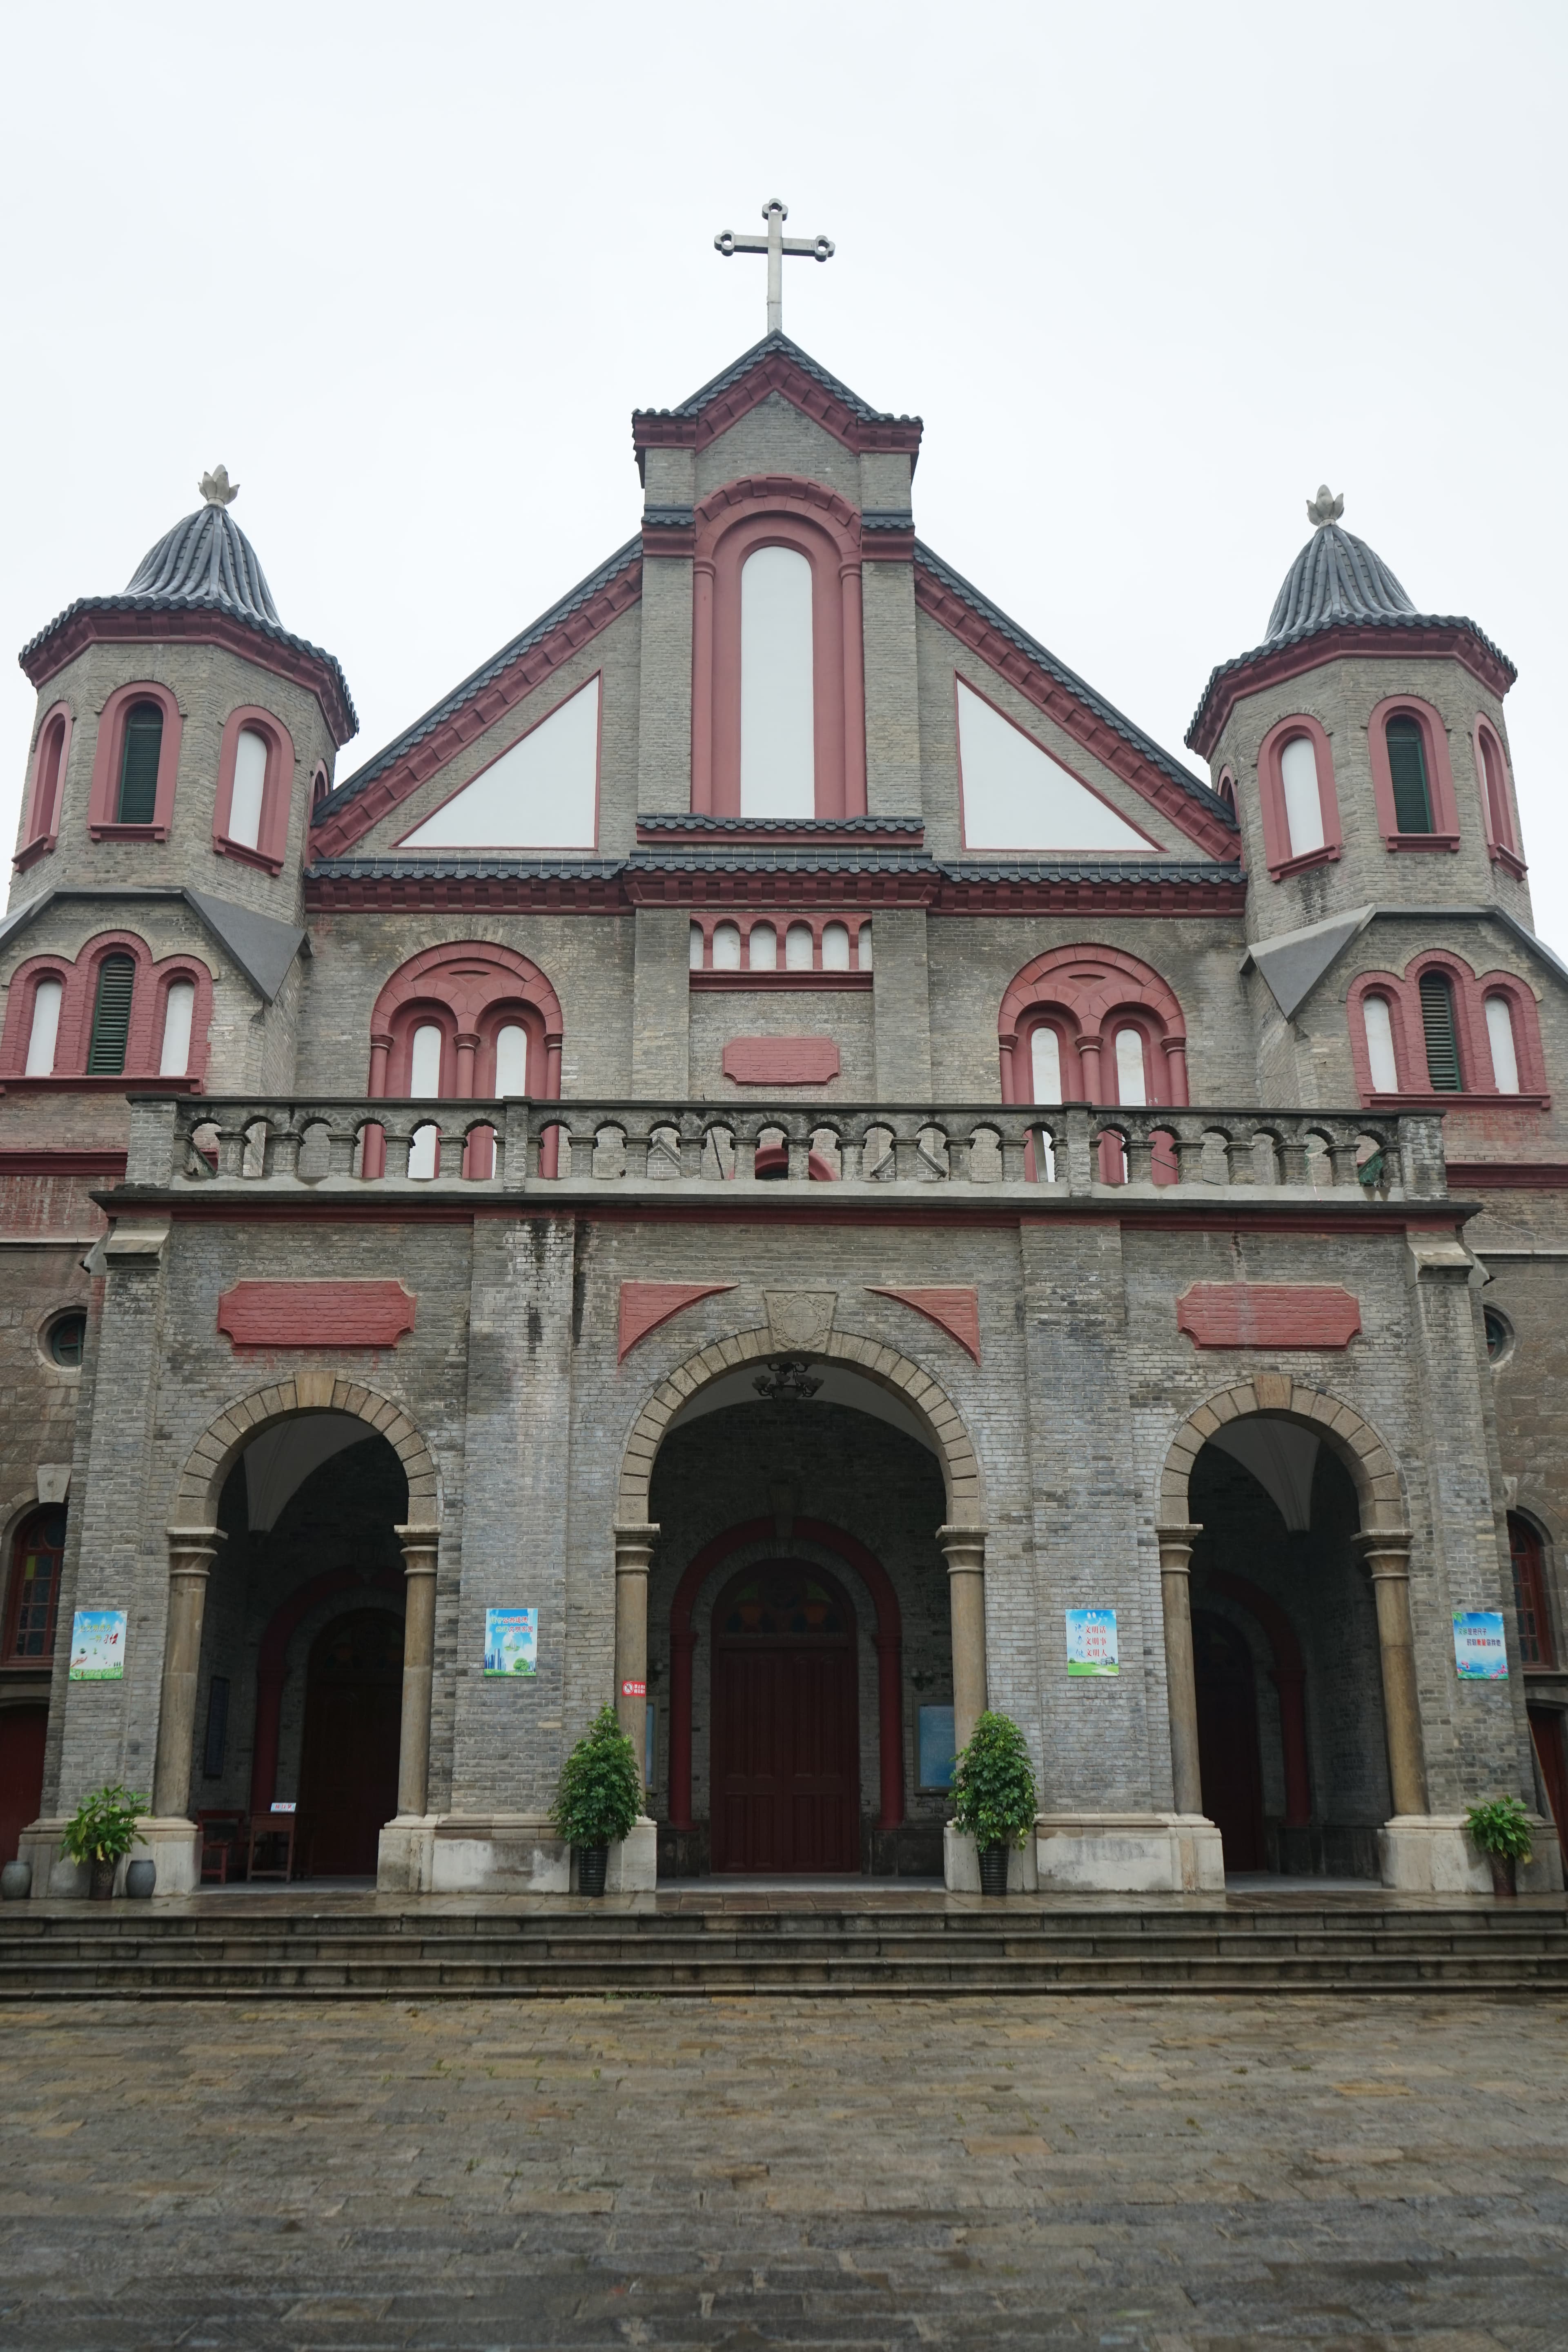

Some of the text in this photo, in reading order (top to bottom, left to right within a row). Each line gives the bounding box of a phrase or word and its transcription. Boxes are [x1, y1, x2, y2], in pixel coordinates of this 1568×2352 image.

[1467, 1638, 1501, 1646] 时刻衡量你我他
